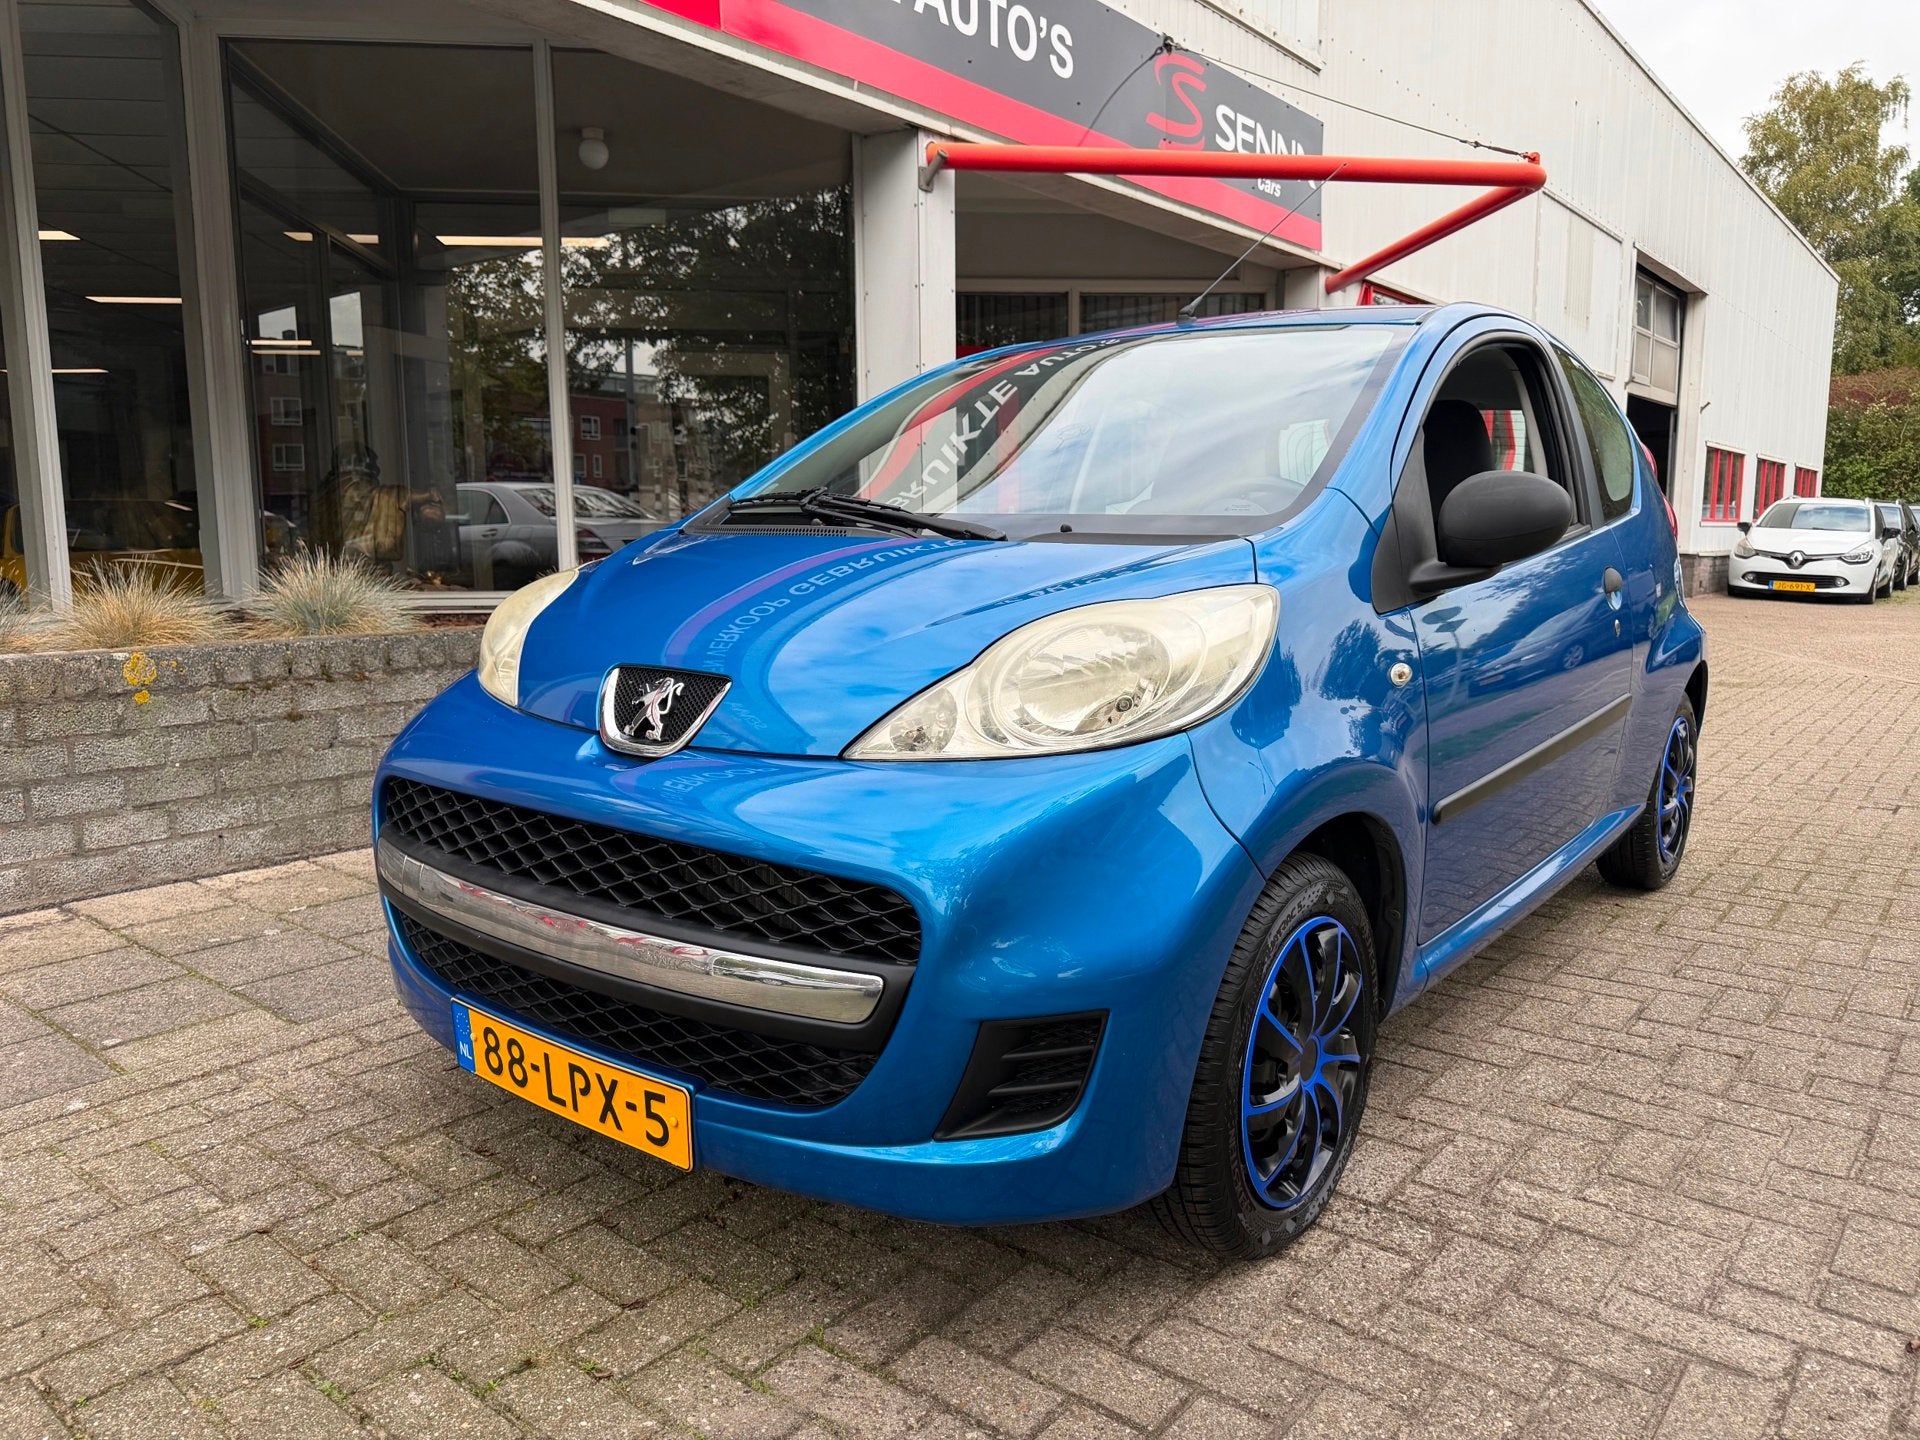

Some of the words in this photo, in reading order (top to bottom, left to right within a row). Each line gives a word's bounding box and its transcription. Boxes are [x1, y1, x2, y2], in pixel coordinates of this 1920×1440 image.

[1215, 104, 1317, 190] SEN
[459, 1041, 472, 1060] NL
[483, 1026, 670, 1147] 88-LPX-5
